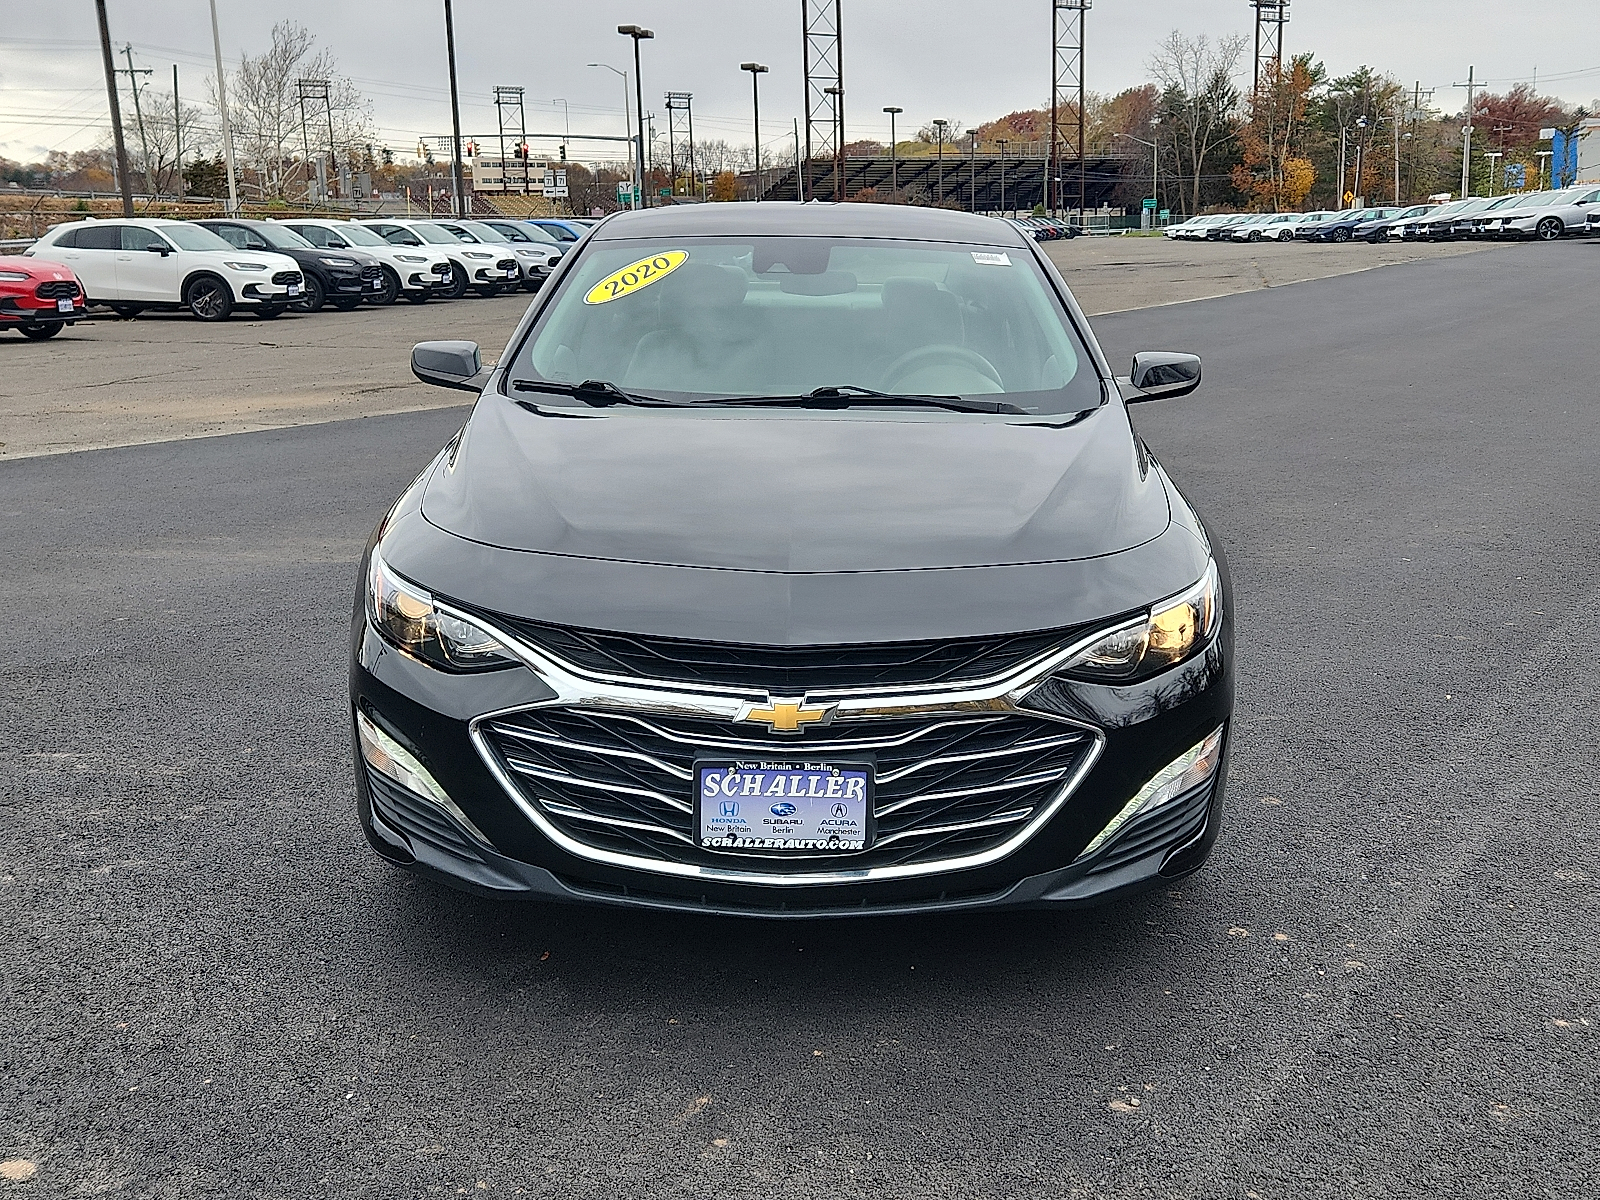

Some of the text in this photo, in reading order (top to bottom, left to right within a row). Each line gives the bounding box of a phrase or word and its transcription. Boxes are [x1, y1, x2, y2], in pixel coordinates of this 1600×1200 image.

[558, 177, 565, 185] 71
[604, 257, 670, 296] 2020
[736, 761, 833, 771] New Britain Berlin
[703, 773, 866, 802] SCHALLER
[727, 824, 751, 833] Britain
[772, 826, 794, 834] Berlin
[817, 827, 861, 836] Manchester
[702, 837, 864, 849] SCHALLERAUTO.COM
